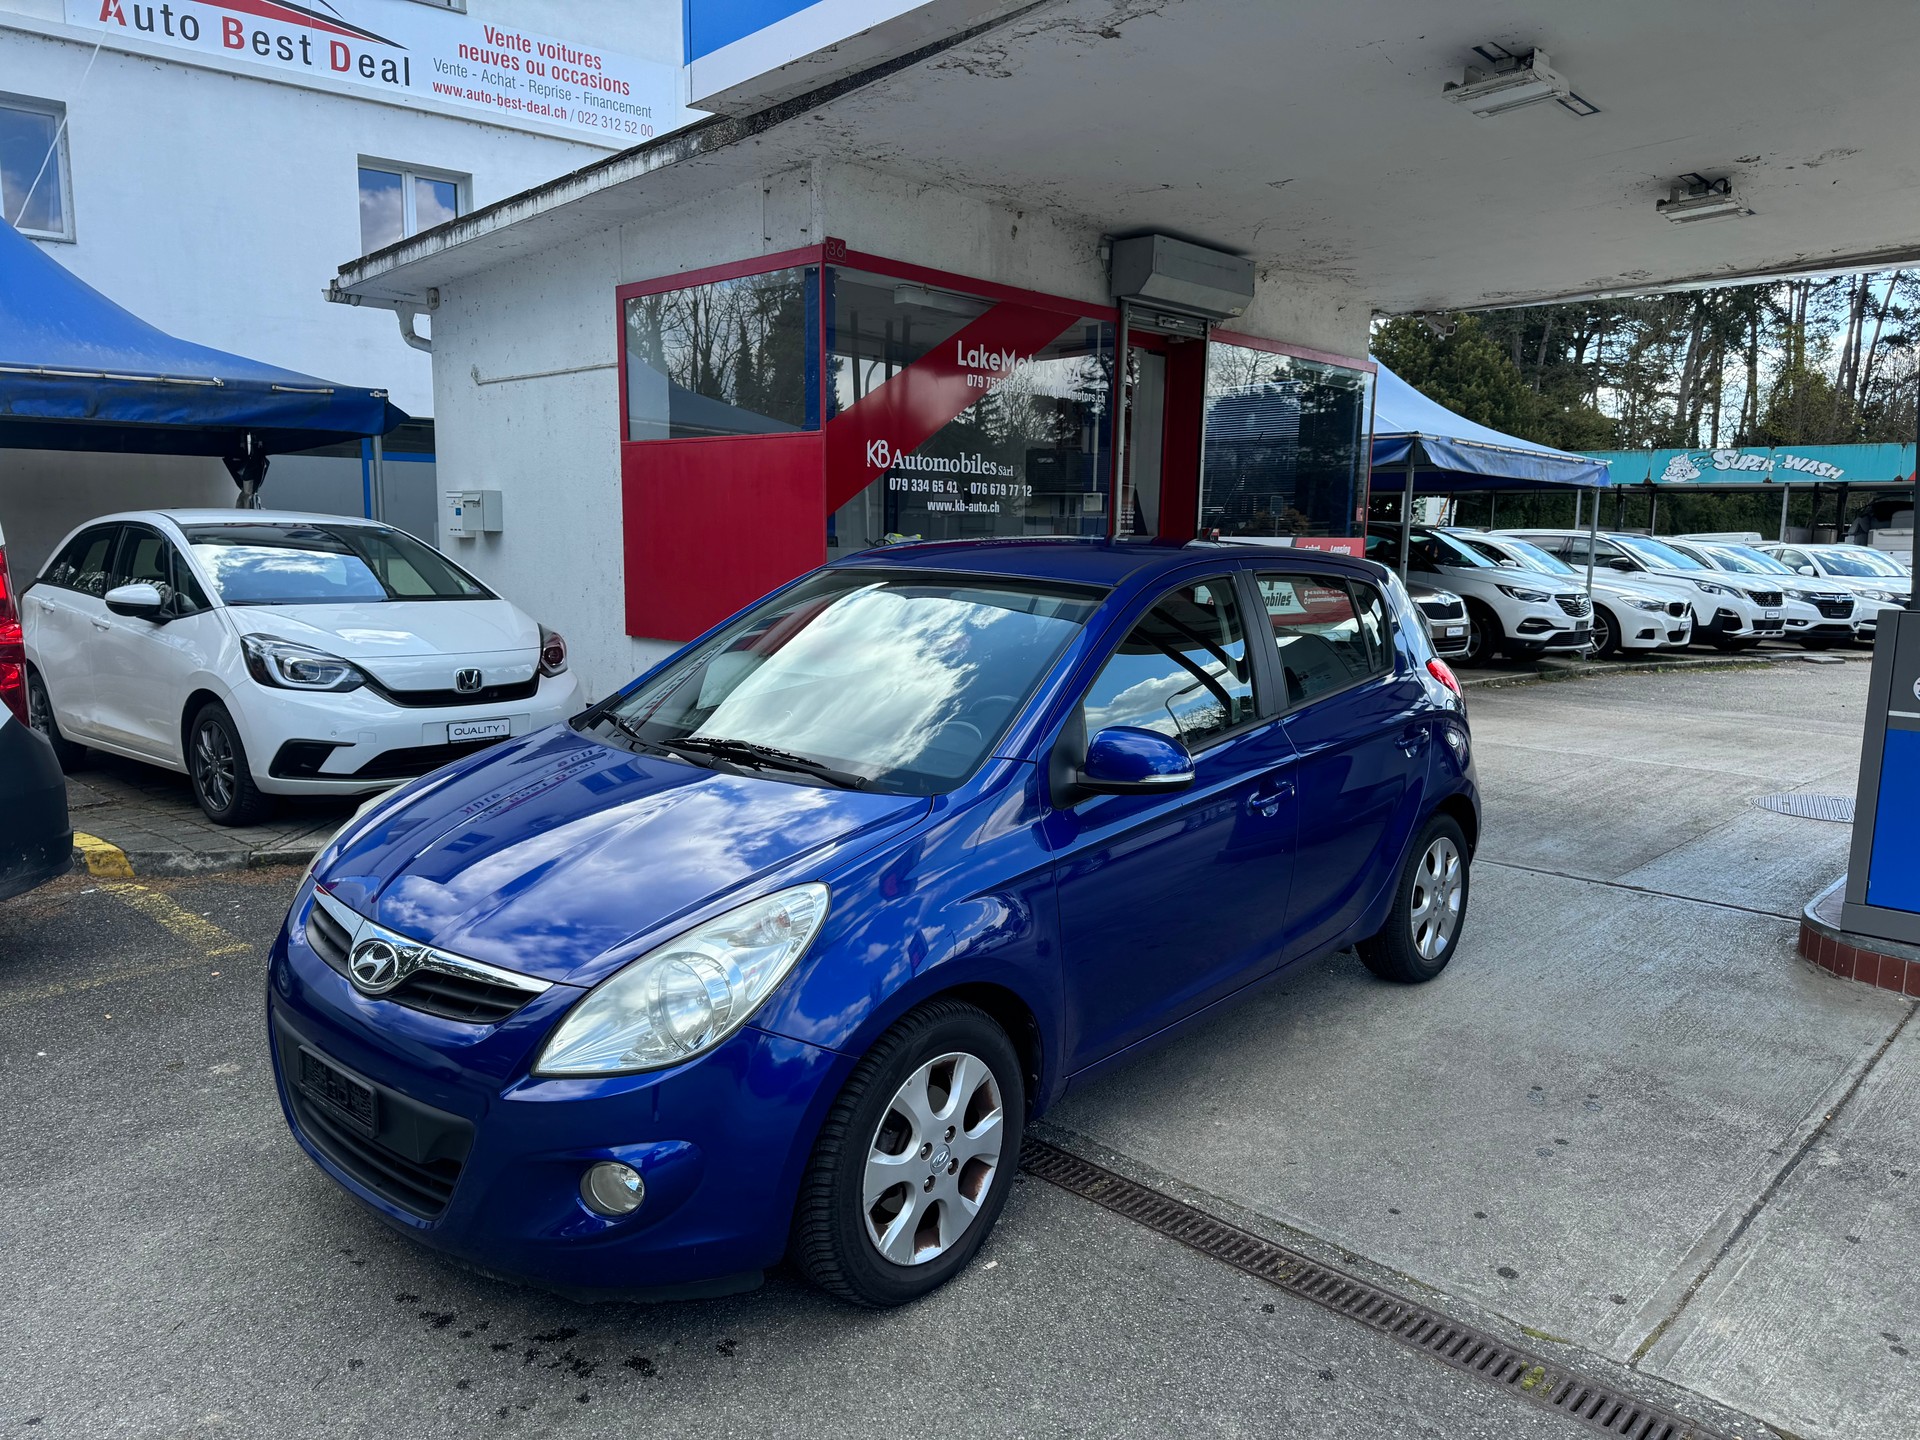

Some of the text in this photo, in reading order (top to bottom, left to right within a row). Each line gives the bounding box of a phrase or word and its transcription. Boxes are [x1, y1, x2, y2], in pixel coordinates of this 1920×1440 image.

[98, 0, 410, 86] Auto Best Deal
[483, 24, 602, 70] Vente voitures
[433, 57, 468, 78] Vente
[481, 69, 516, 89] Achat
[528, 79, 572, 101] Reprise
[583, 91, 652, 118] Financement
[458, 43, 630, 96] neuves ou occasions
[432, 82, 567, 120] www.auto-best-deal.ch
[577, 110, 598, 127] 022
[601, 115, 621, 131] 312
[624, 120, 638, 134] 52
[640, 123, 654, 138] 00
[829, 241, 844, 258] 36
[957, 339, 1057, 378] LakeMotors
[967, 373, 984, 389] 079
[986, 376, 1002, 391] 753
[866, 439, 891, 469] KB
[891, 449, 997, 475] Automobiles
[1712, 449, 1845, 480] SUPER WASH
[889, 477, 909, 492] 079
[911, 479, 930, 493] 334
[932, 480, 944, 493] 65
[946, 481, 959, 494] 41
[970, 482, 987, 496] 076
[990, 483, 1007, 496] 679
[1009, 484, 1019, 497] 77
[1022, 485, 1033, 498] 12
[927, 500, 1000, 514] www.kb-auto.ch
[453, 725, 500, 736] QUALITY
